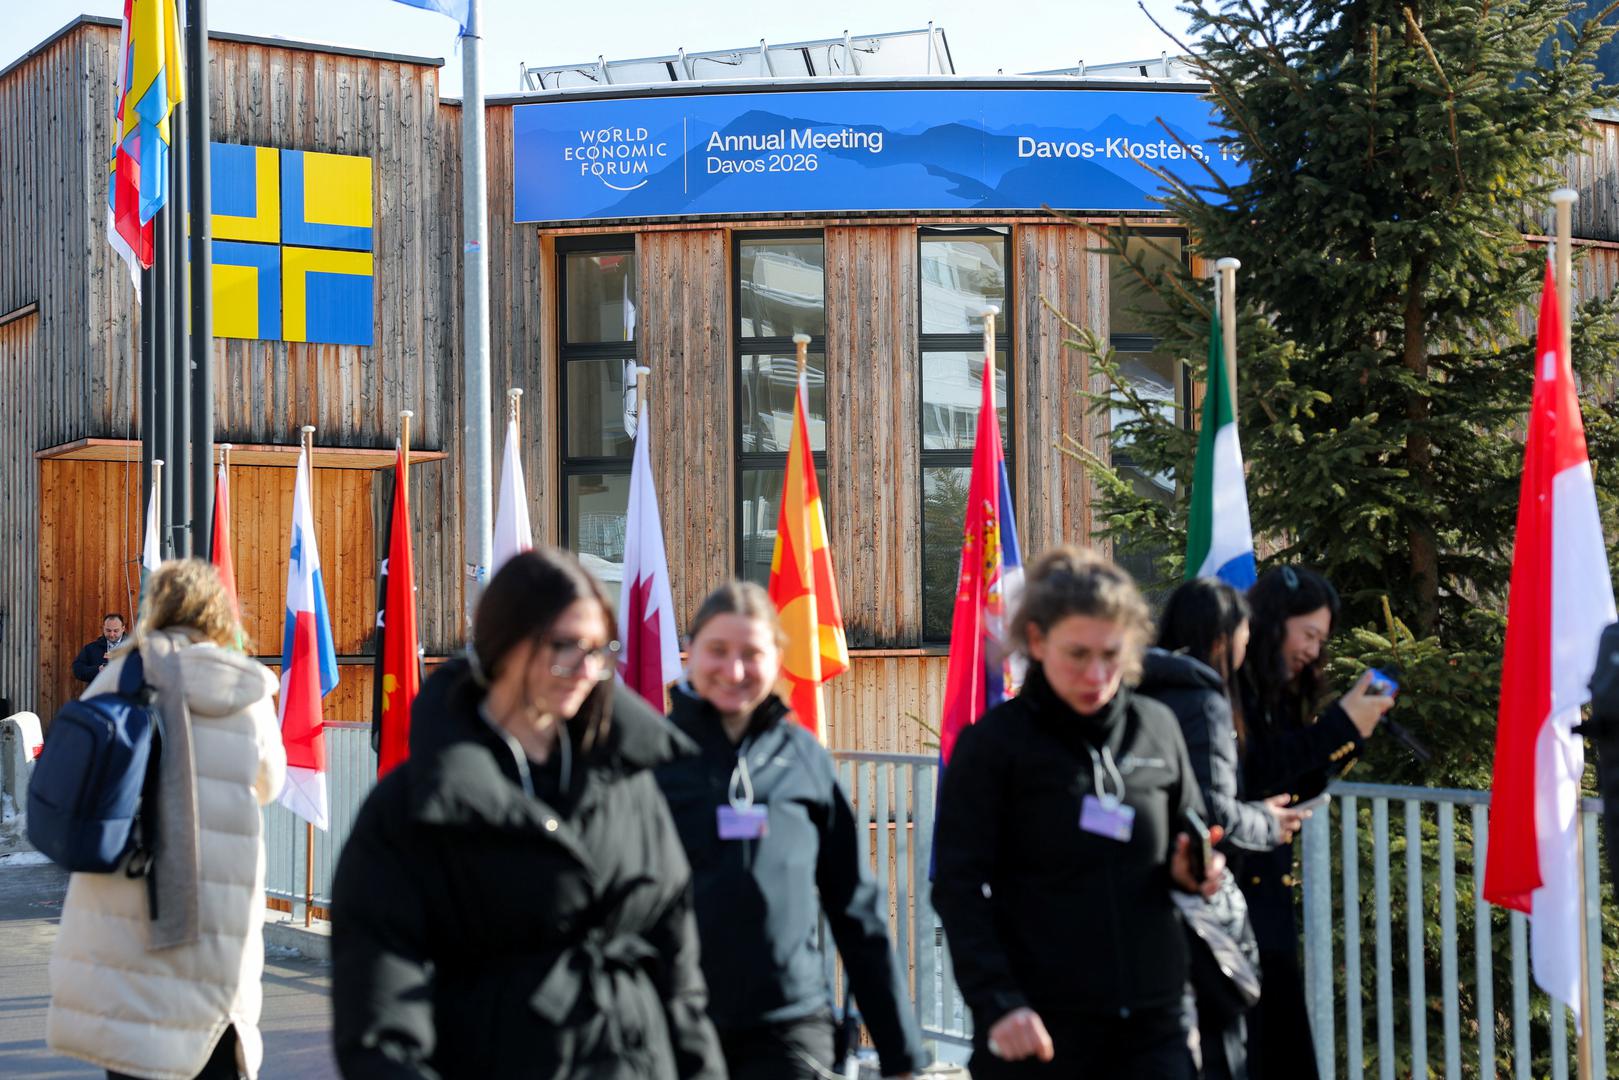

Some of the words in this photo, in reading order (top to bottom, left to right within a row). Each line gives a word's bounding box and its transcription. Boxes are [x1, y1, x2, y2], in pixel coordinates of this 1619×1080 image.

[580, 127, 648, 143] WORLD
[706, 129, 785, 152] Annual
[790, 128, 883, 152] Meeting
[565, 142, 667, 161] ECONOMIC
[1018, 136, 1210, 164] Davos-Klosters,
[581, 160, 648, 176] FORUM
[707, 156, 765, 174] Davos
[768, 153, 818, 172] 2026
